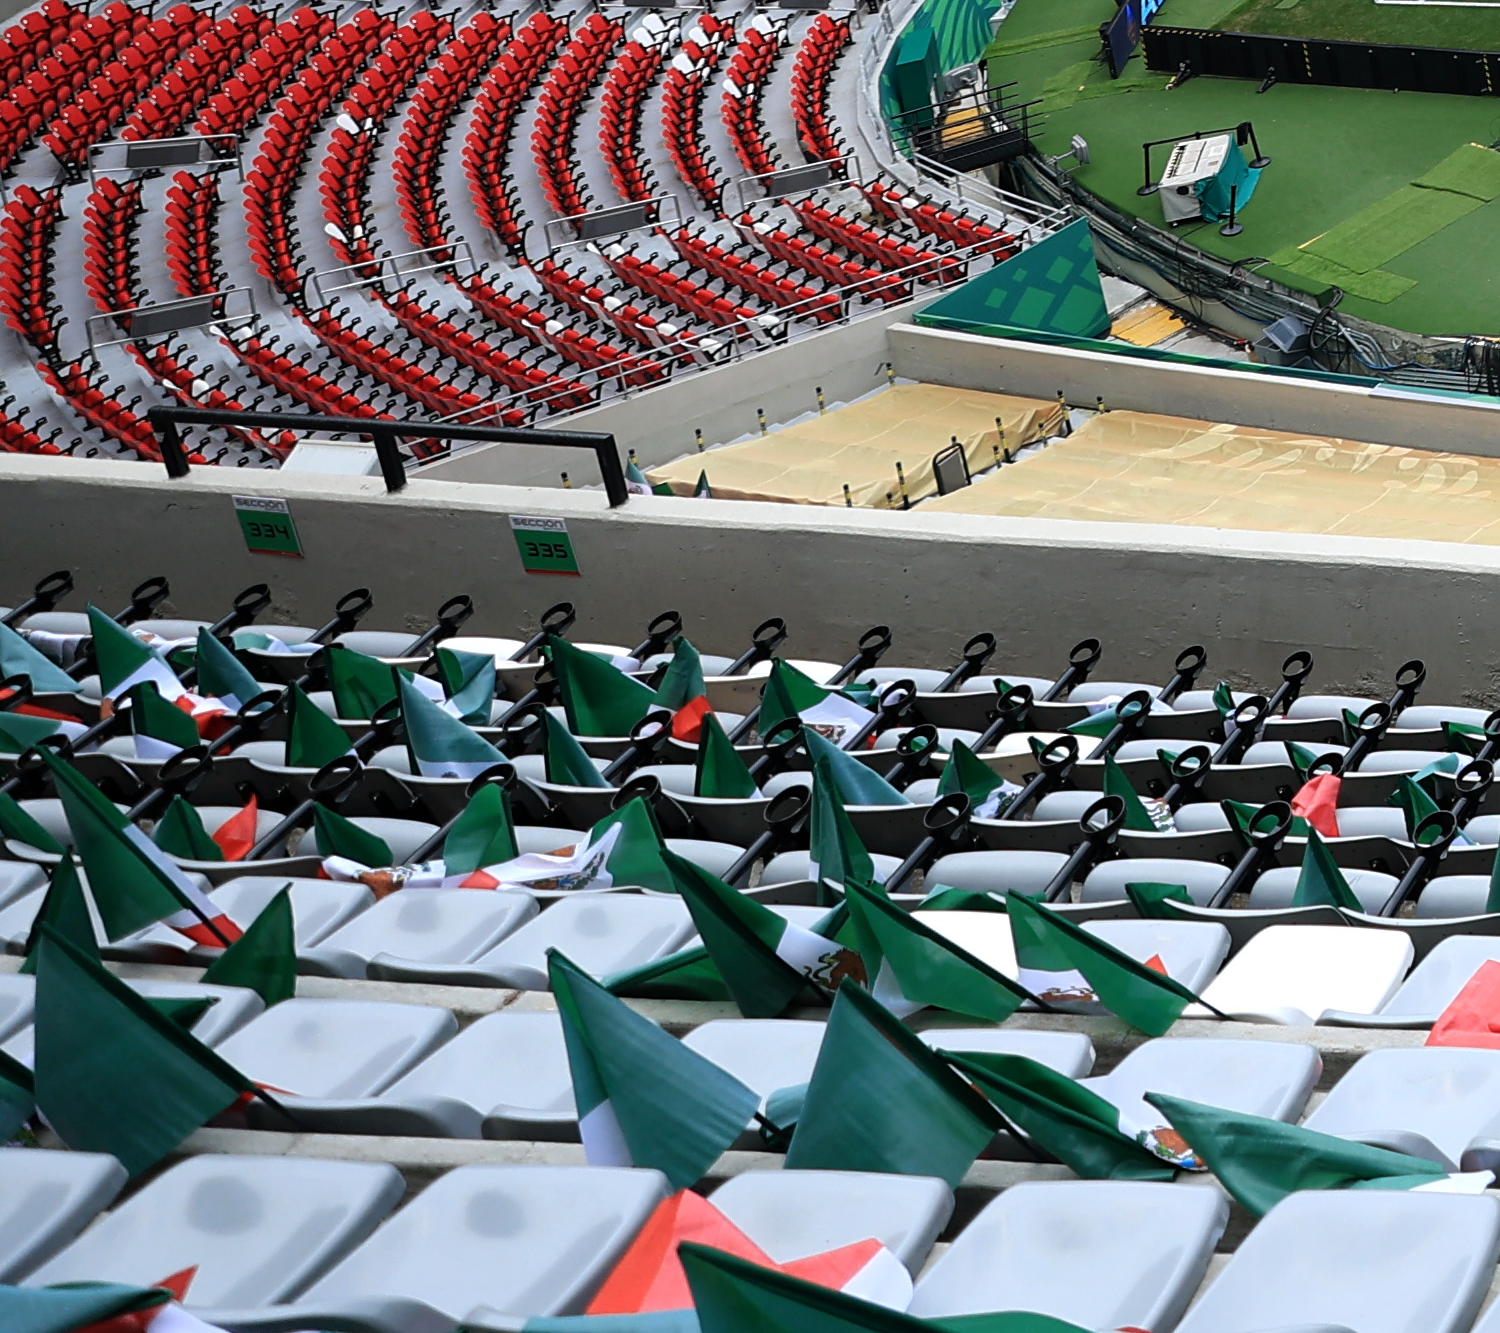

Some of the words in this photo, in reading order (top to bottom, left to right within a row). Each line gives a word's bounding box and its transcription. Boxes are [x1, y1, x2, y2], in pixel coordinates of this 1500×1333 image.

[235, 497, 285, 511] SECCIÓN
[247, 521, 290, 540] 334
[512, 516, 564, 529] SECCIÓN
[524, 541, 568, 559] 335
